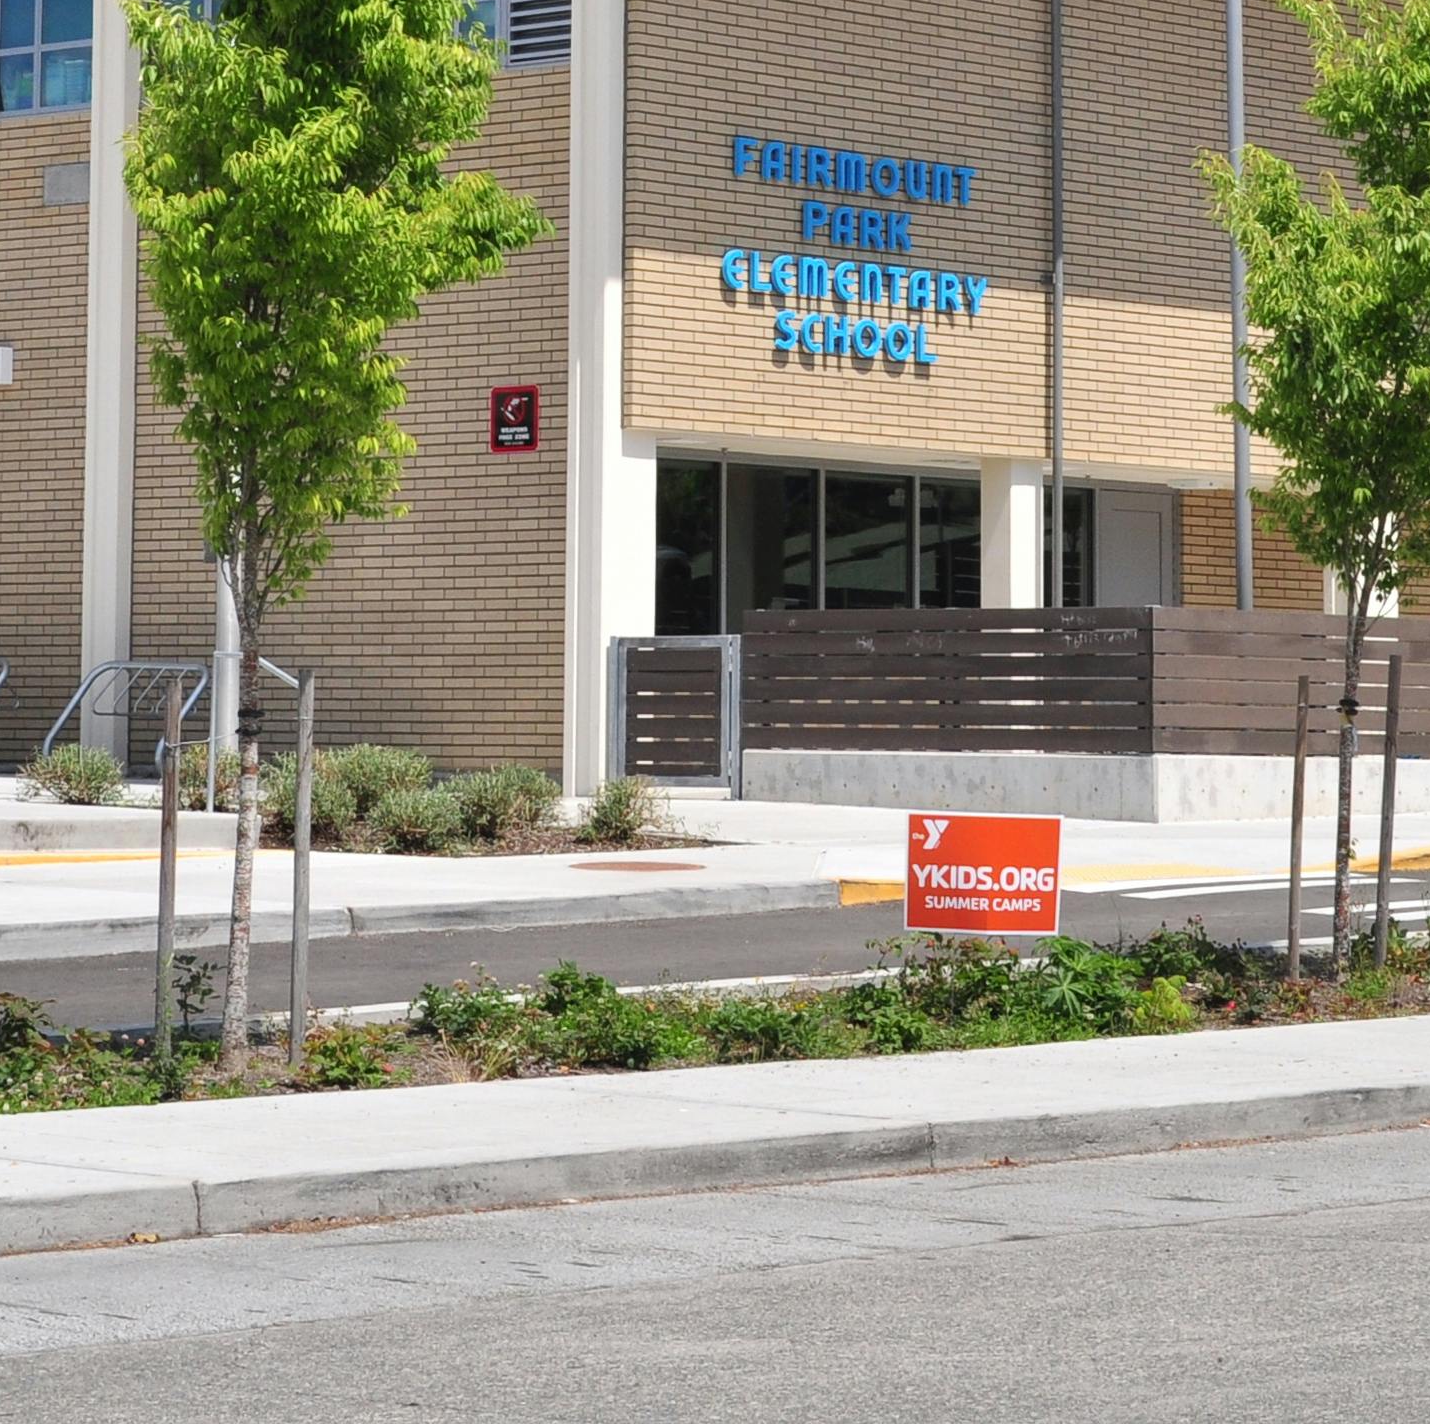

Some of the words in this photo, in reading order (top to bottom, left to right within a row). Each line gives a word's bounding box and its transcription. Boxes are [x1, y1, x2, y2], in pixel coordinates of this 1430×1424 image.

[733, 134, 976, 206] FAIRMOUNT
[802, 200, 913, 251] PARK
[722, 248, 988, 316] ELEMENTARY
[774, 309, 938, 364] SCHOOL
[912, 863, 1055, 892] YKIDS.ORG
[925, 895, 989, 911] SUMMER
[992, 897, 1041, 912] CAMPS
